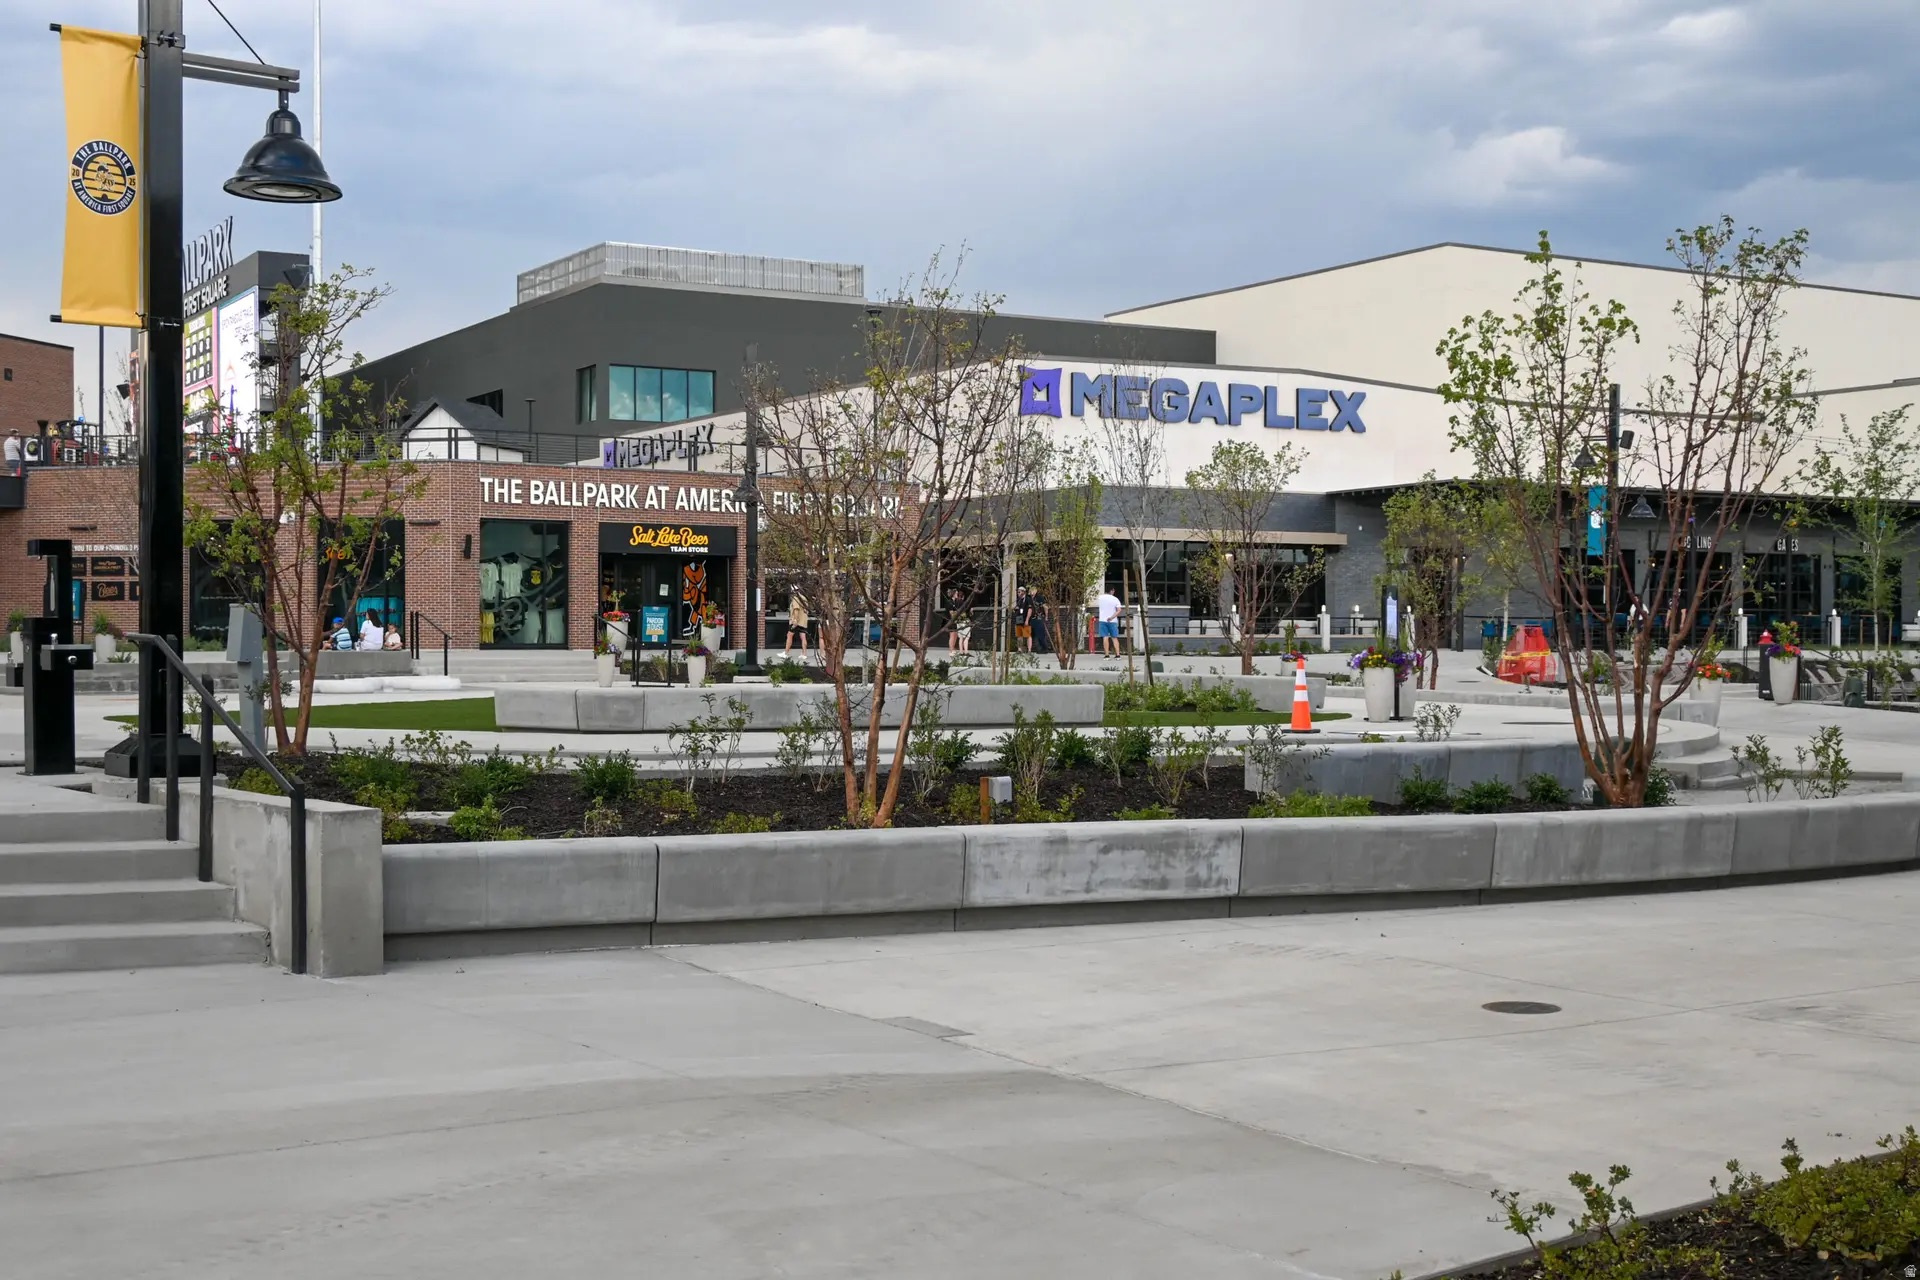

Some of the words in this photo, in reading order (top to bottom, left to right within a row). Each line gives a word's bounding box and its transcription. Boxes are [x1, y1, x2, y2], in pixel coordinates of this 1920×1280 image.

[75, 145, 91, 161] THE
[92, 142, 132, 169] BALLPARK
[72, 168, 80, 177] 20
[129, 178, 136, 186] 25
[74, 182, 82, 190] AT
[78, 190, 101, 212] AMERICA
[102, 204, 119, 213] FIRST
[118, 189, 134, 210] SQUARE
[183, 215, 234, 294] LLPARK
[184, 291, 202, 318] FIRST
[201, 275, 229, 309] SQUARE
[1070, 371, 1367, 433] MEGAPLEX
[616, 422, 714, 468] MEGAPLEX
[479, 477, 523, 505] THE
[530, 480, 639, 509] BALLPARK
[645, 485, 670, 510] AT
[675, 486, 766, 515] AMERI
[629, 525, 655, 546] Salt
[651, 526, 681, 547] Lake
[680, 527, 709, 547] Bees
[1682, 535, 1712, 549] OLING
[1777, 538, 1799, 552] GAES
